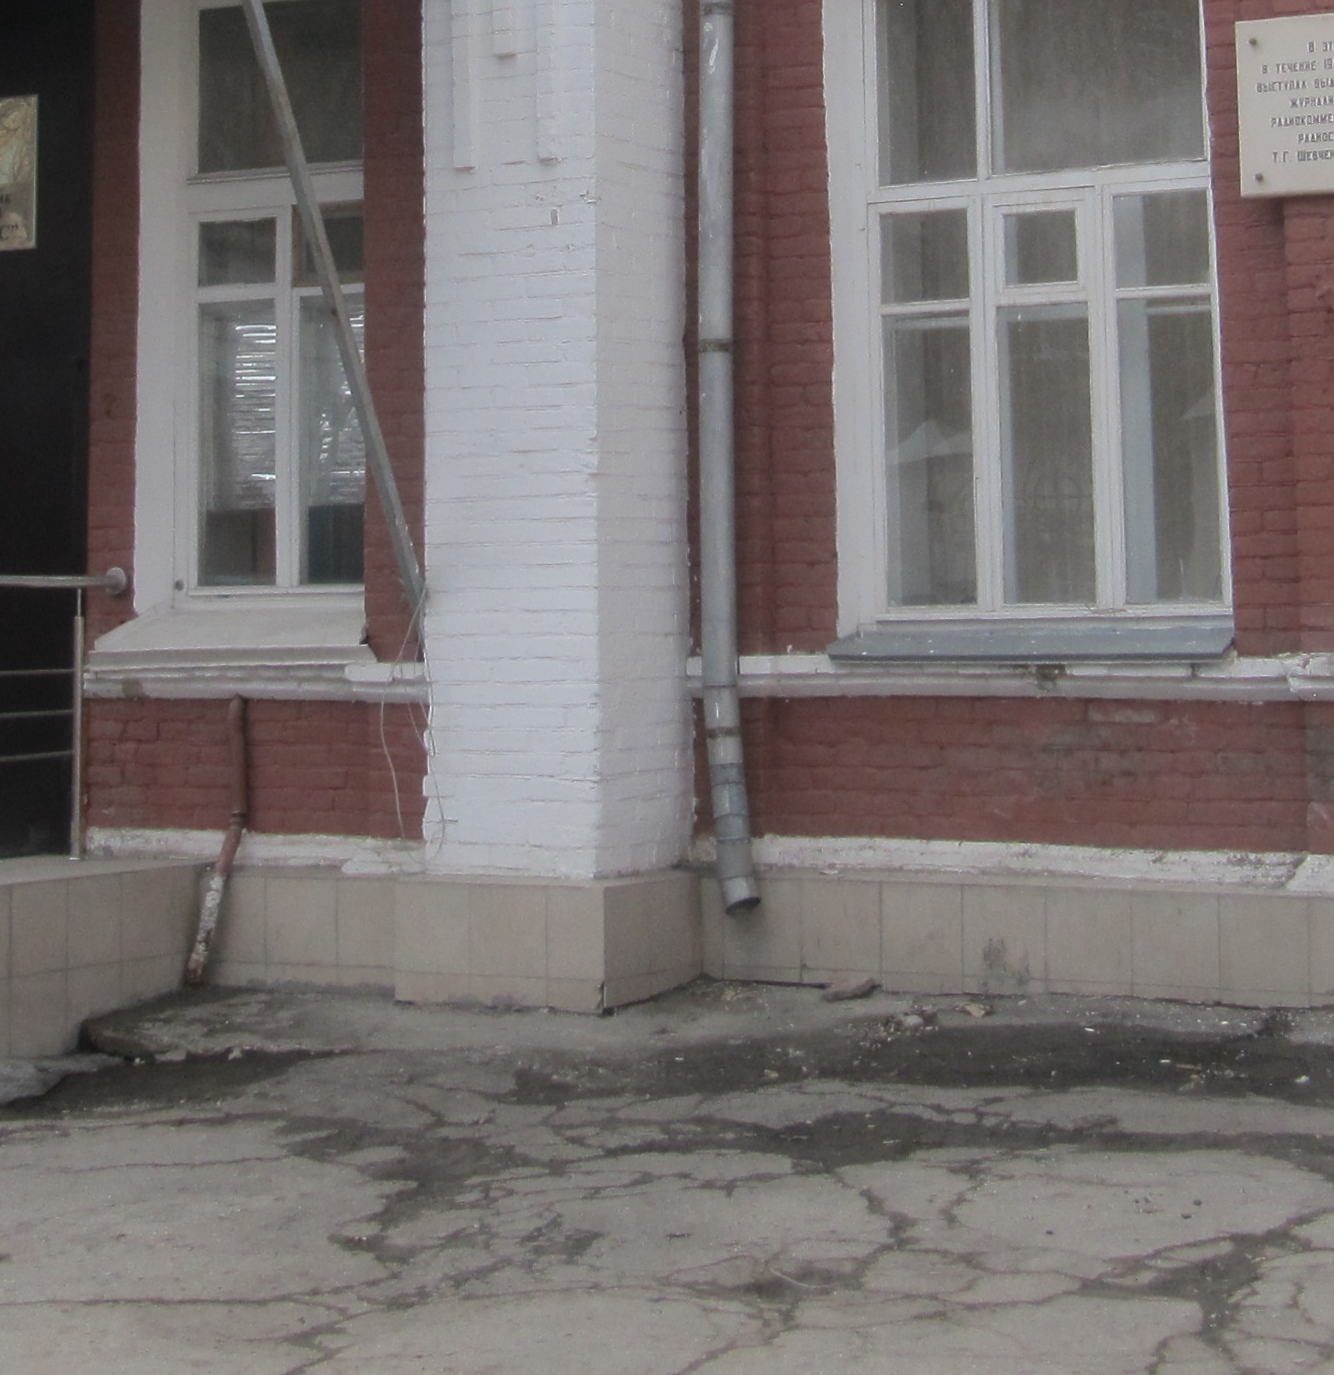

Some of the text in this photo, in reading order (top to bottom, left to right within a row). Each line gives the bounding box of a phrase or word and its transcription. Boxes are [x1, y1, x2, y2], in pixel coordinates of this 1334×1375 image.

[1308, 42, 1314, 53] В
[1262, 65, 1268, 74] В
[1276, 60, 1316, 73] ТЕЧЕНИЕ
[1257, 80, 1306, 92] ВЫСТУПАЛ
